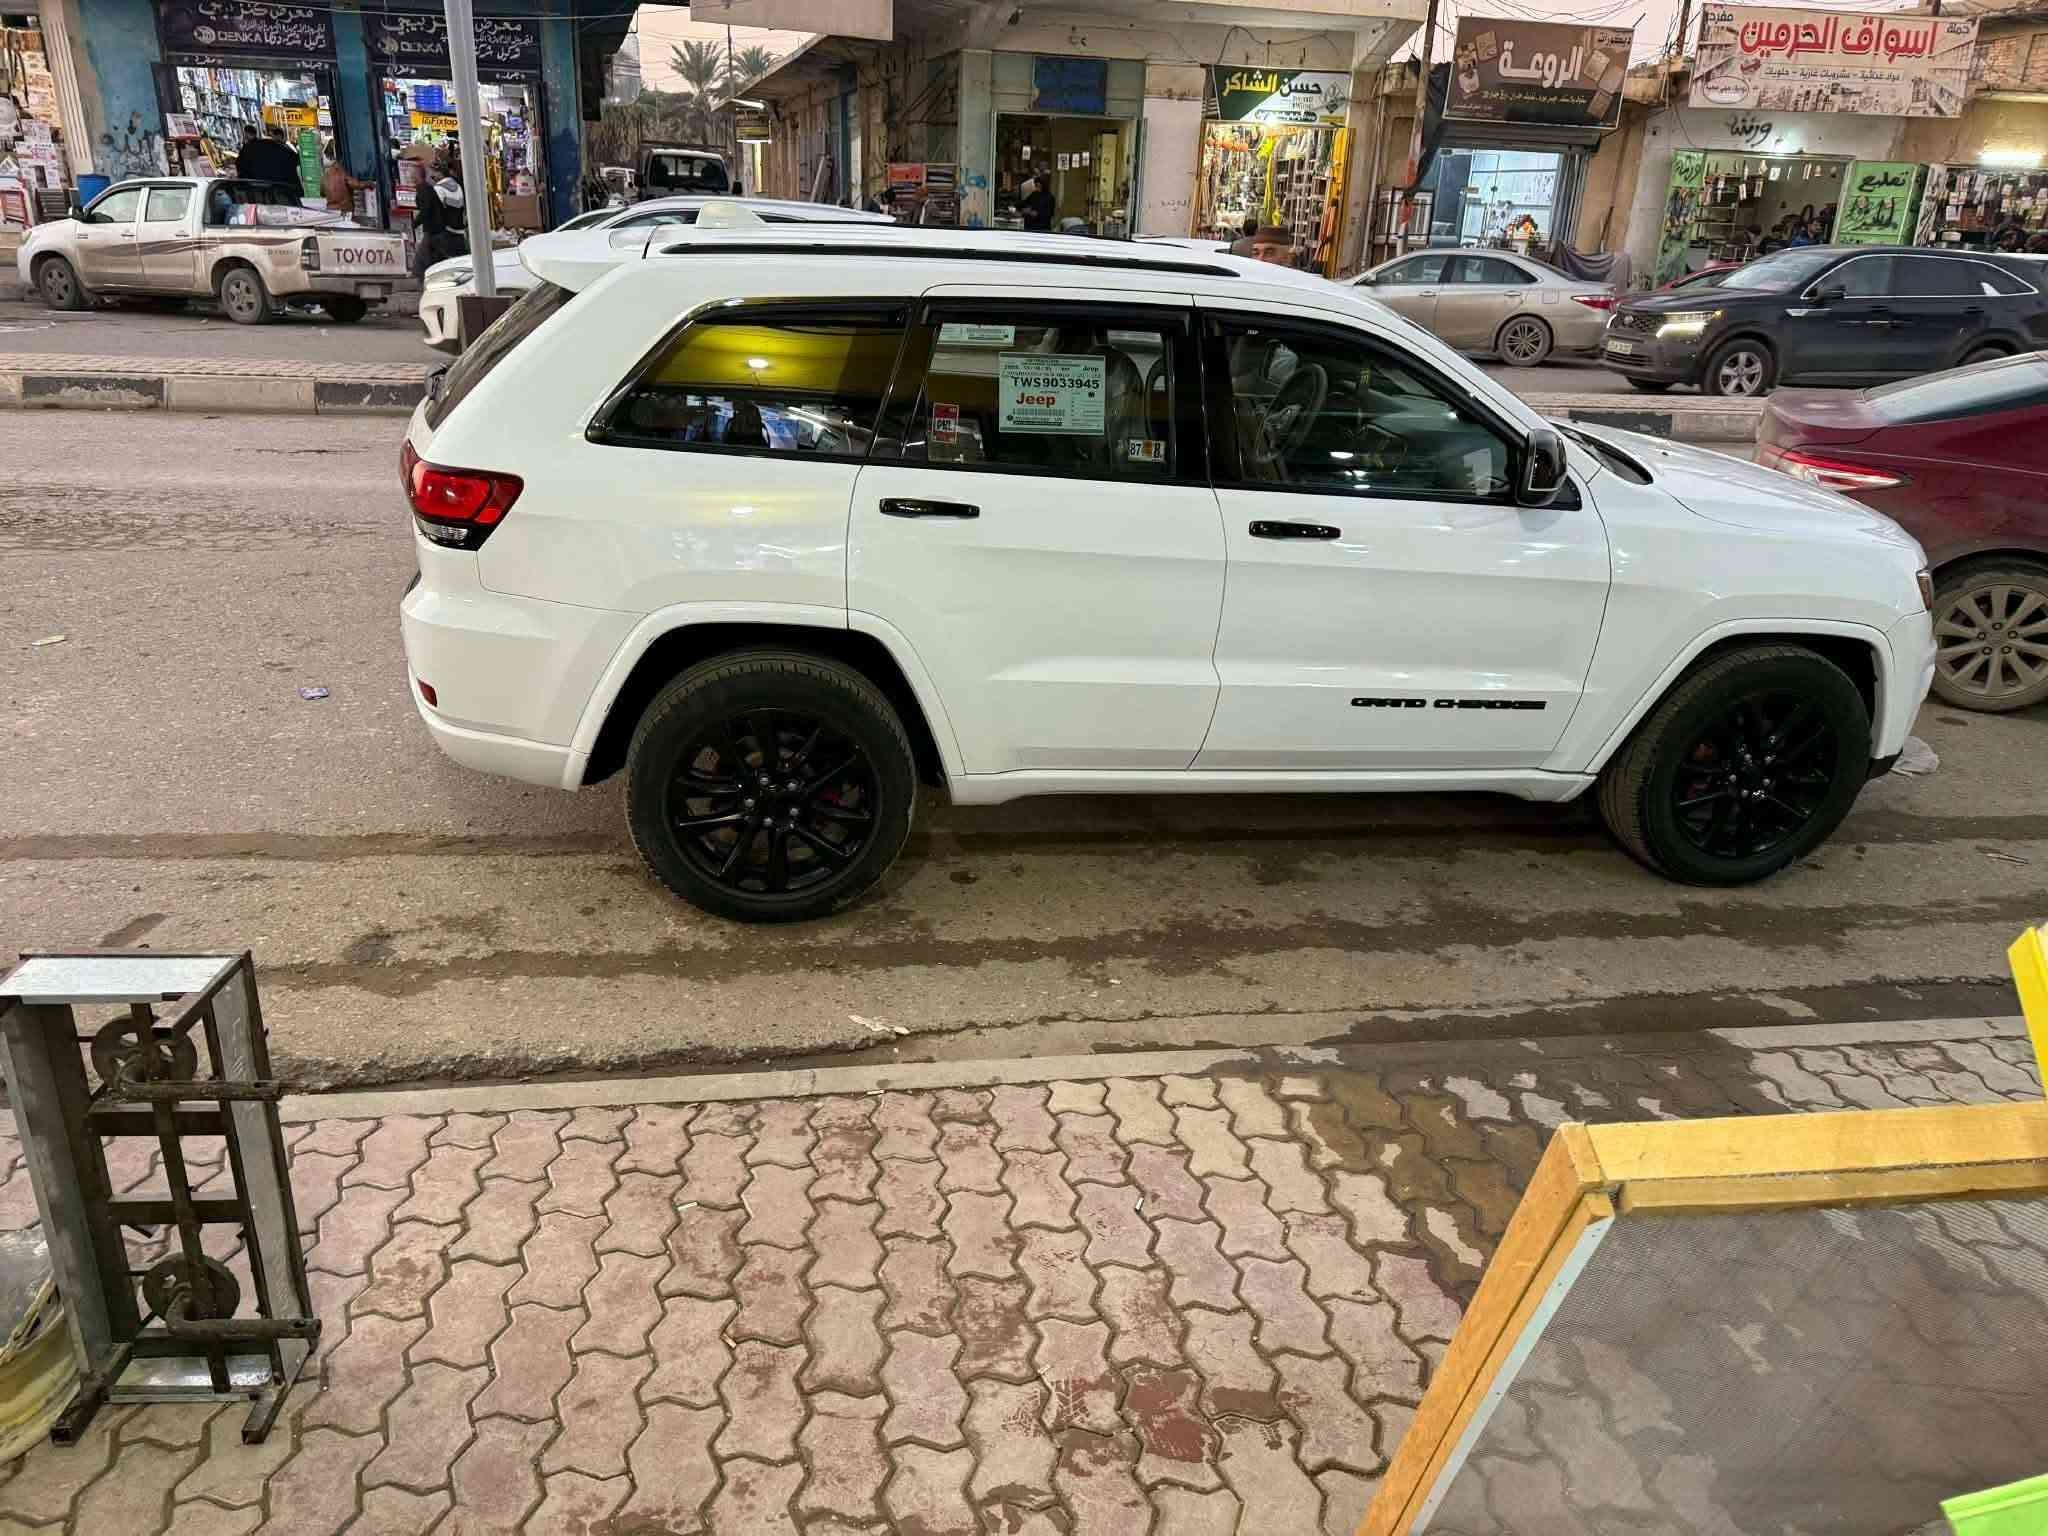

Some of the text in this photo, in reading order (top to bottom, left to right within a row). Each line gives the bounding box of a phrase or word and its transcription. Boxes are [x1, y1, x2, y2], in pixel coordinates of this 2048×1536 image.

[1707, 11, 1734, 24] مفرد
[475, 19, 522, 34] معرض
[218, 31, 262, 44] DENKA
[1739, 16, 1938, 63] اسواق الحرمين
[1499, 40, 1584, 88] الروعة
[1222, 69, 1322, 97] حسن الشاكر
[333, 248, 396, 264] TOYOTA
[1011, 376, 1100, 389] TWS9033945
[1015, 392, 1056, 408] Jeep
